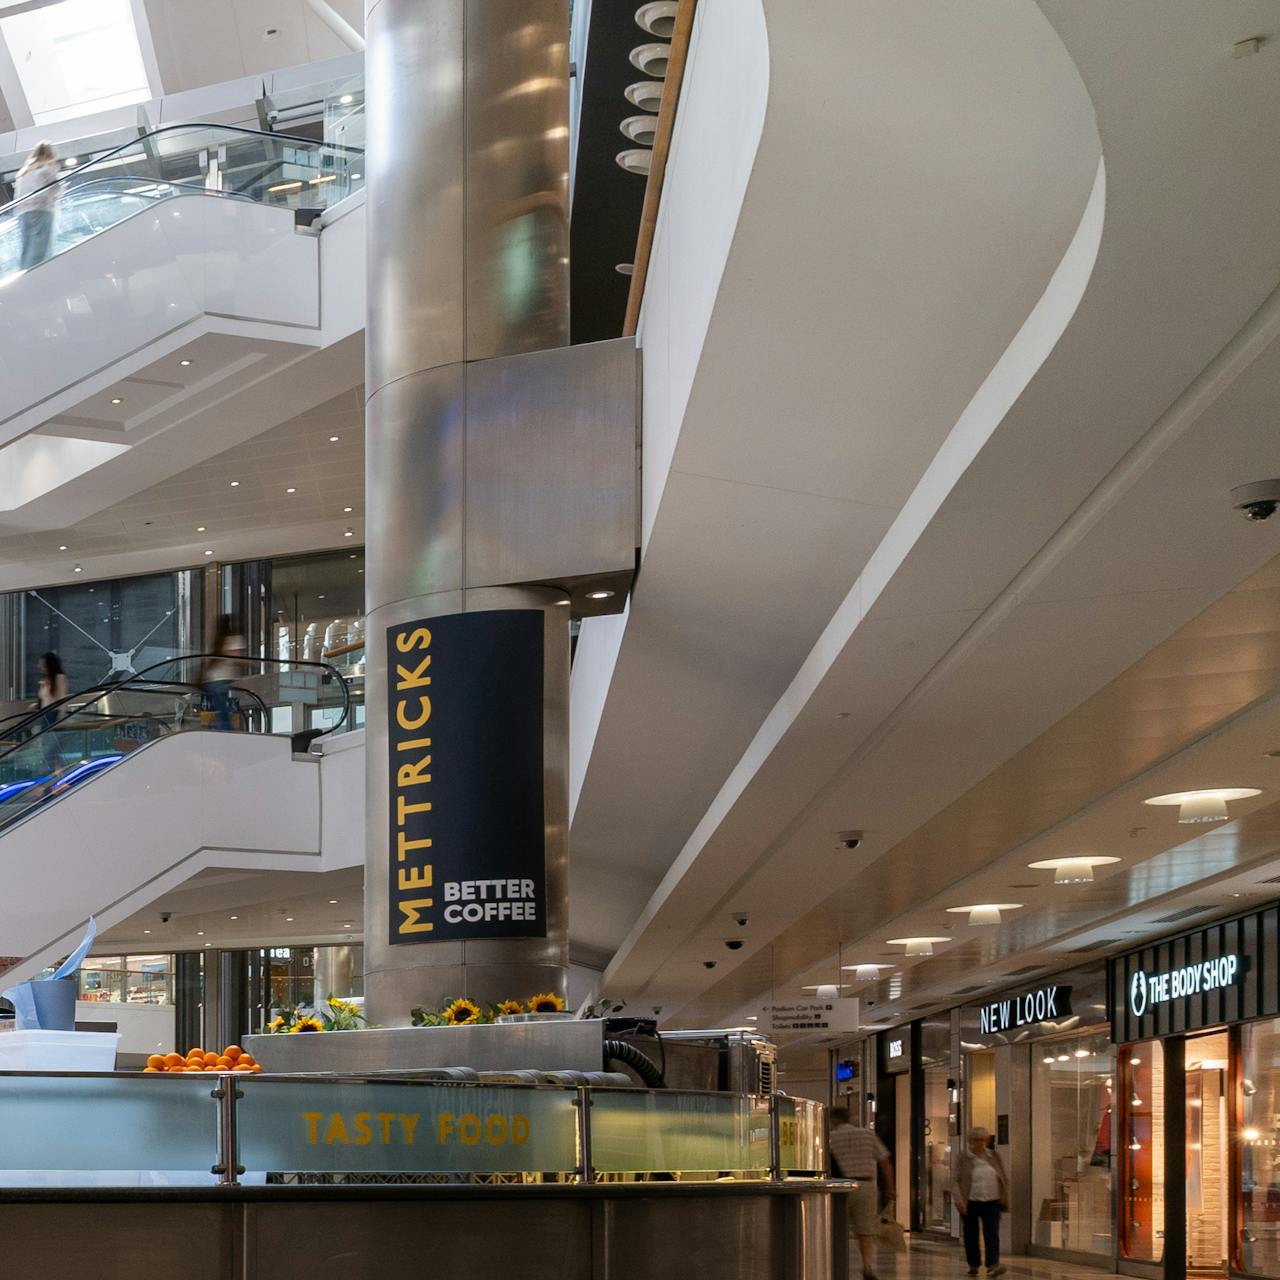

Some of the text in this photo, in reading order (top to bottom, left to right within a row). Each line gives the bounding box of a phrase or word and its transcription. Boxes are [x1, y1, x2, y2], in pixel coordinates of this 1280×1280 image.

[396, 625, 434, 935] METTRICKS
[443, 878, 535, 901] BETTER
[443, 901, 536, 924] COFFEE
[1149, 954, 1238, 1004] THE BODY SHOP
[980, 986, 1057, 1034] NEW LOOK
[303, 1111, 531, 1146] TASTY FOOD
